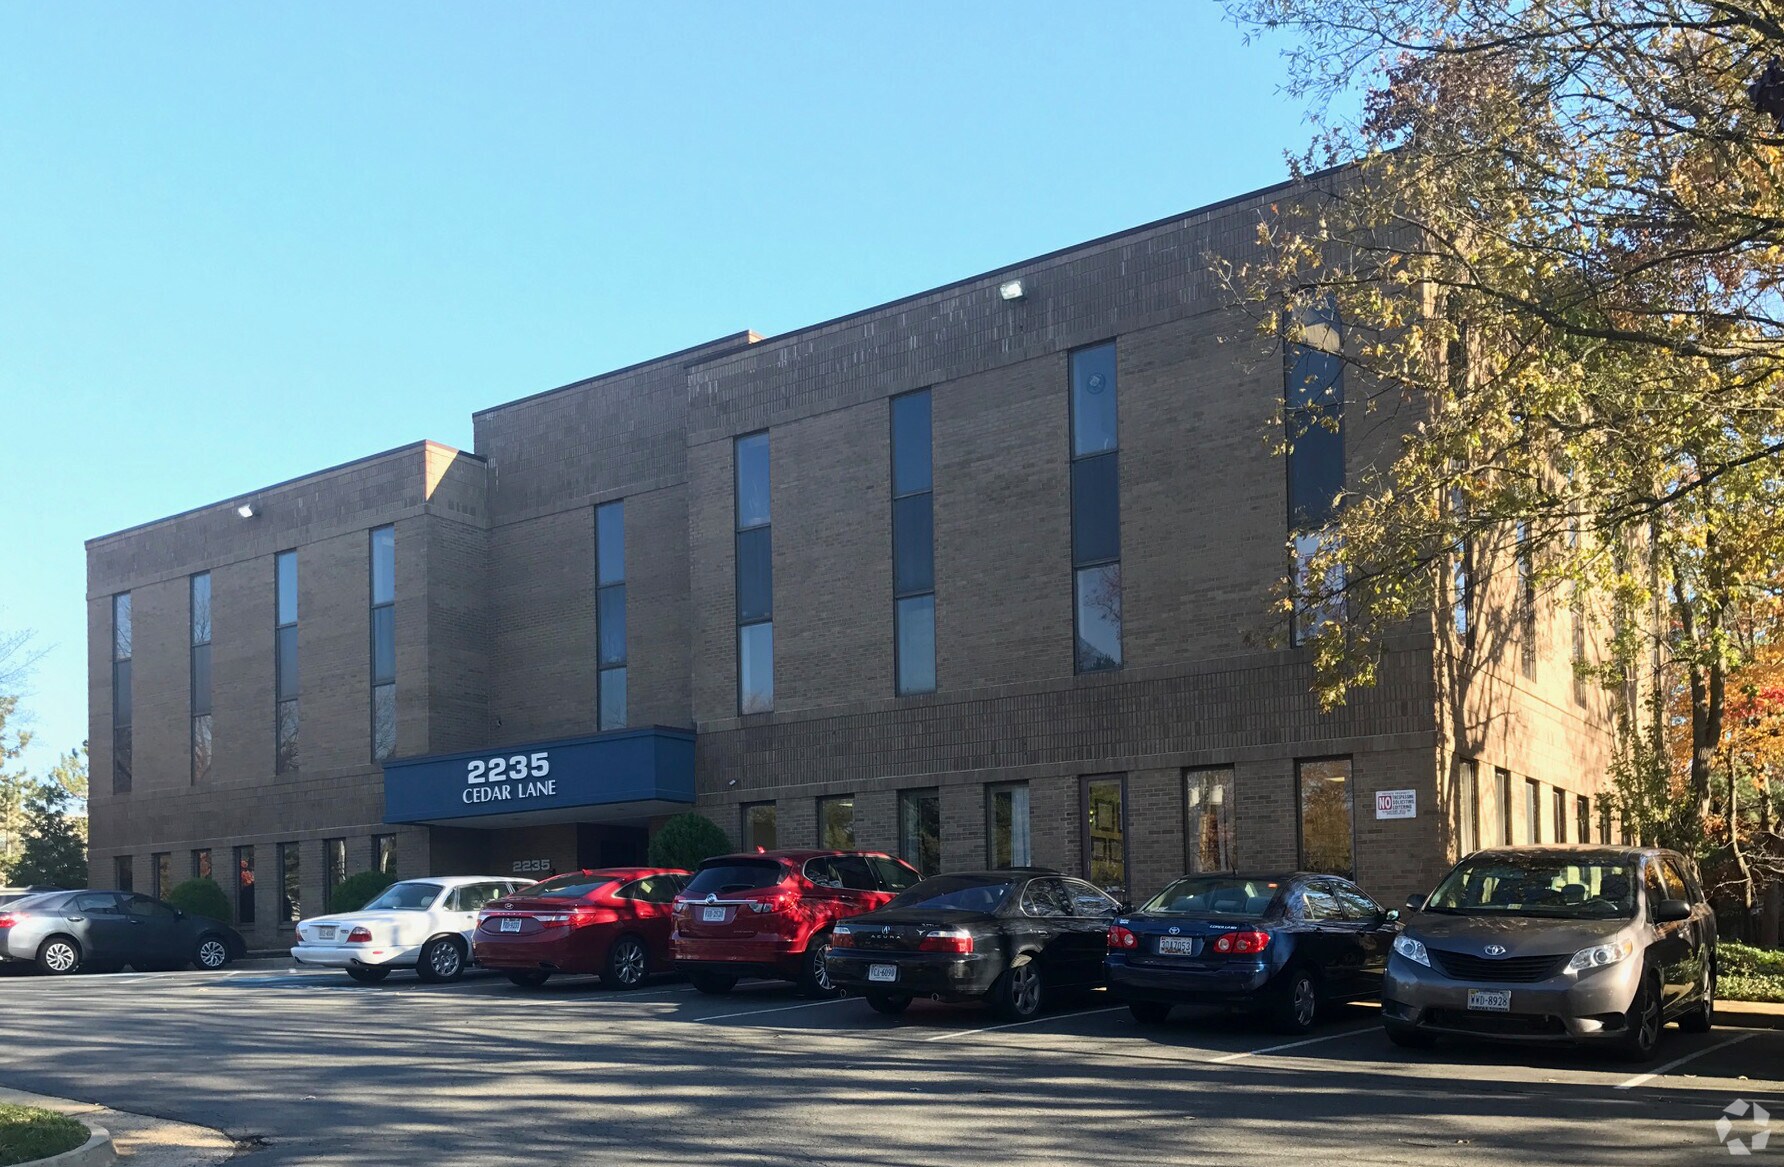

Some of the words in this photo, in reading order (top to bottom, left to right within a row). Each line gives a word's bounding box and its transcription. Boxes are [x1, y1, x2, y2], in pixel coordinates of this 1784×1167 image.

[467, 752, 550, 784] 2235
[462, 785, 511, 804] CEDAR
[518, 779, 556, 798] LANE
[1379, 796, 1391, 810] NO
[512, 859, 551, 872] 2235
